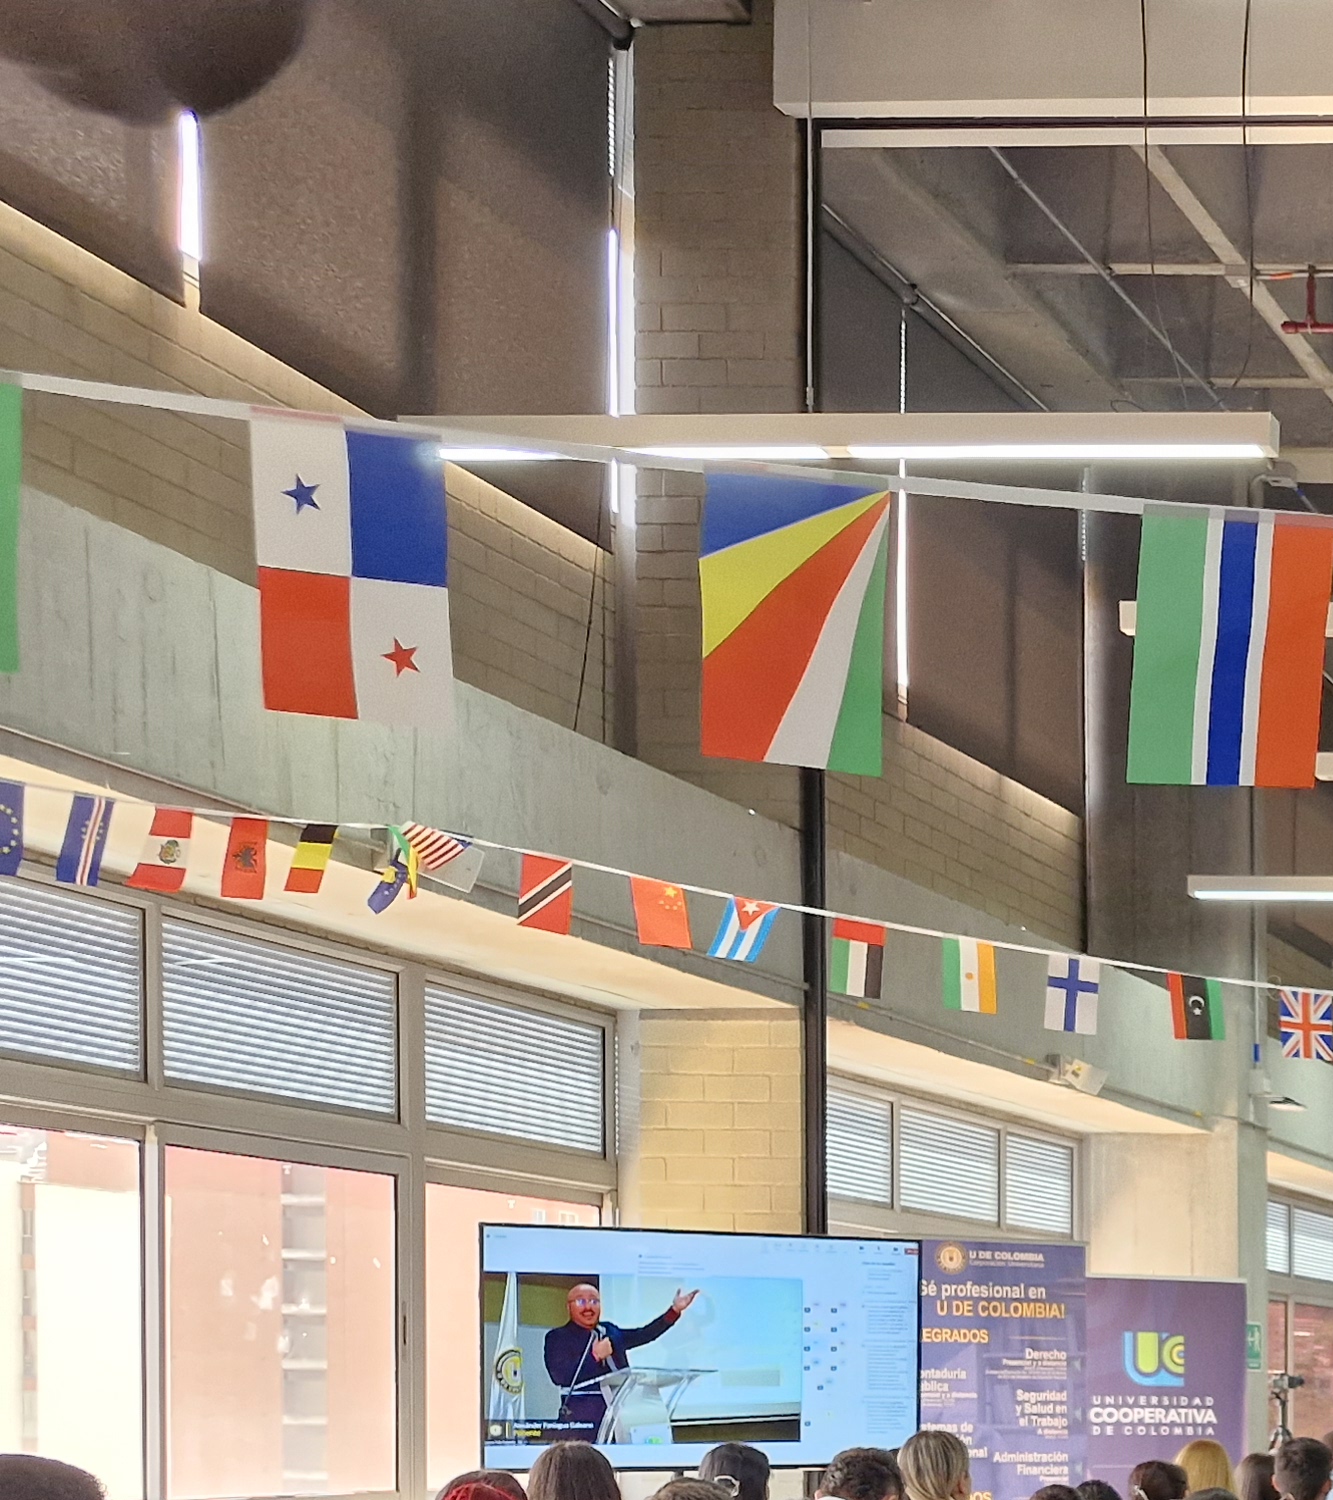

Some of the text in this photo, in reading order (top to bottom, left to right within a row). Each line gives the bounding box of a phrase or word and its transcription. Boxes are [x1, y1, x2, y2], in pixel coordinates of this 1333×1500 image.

[978, 1251, 992, 1260] DE
[994, 1251, 1045, 1262] COLOMBIA
[941, 1280, 1025, 1300] profesional
[1028, 1287, 1046, 1299] en
[936, 1300, 1066, 1319] U DE COLOMBIA!
[921, 1328, 989, 1343] EGRADOS
[1025, 1348, 1067, 1360] Derecho
[1016, 1389, 1067, 1404] Seguridad
[1092, 1395, 1215, 1406] UNIVERSIDAD
[1016, 1403, 1067, 1416] y Salud en
[1090, 1407, 1218, 1424] COOPERATIVA
[960, 1421, 974, 1433] de
[1019, 1416, 1068, 1429] el Trabajo
[1092, 1426, 1215, 1436] DE COLOMBIA
[993, 1452, 1068, 1463] Administración
[1017, 1464, 1068, 1476] Financiera
